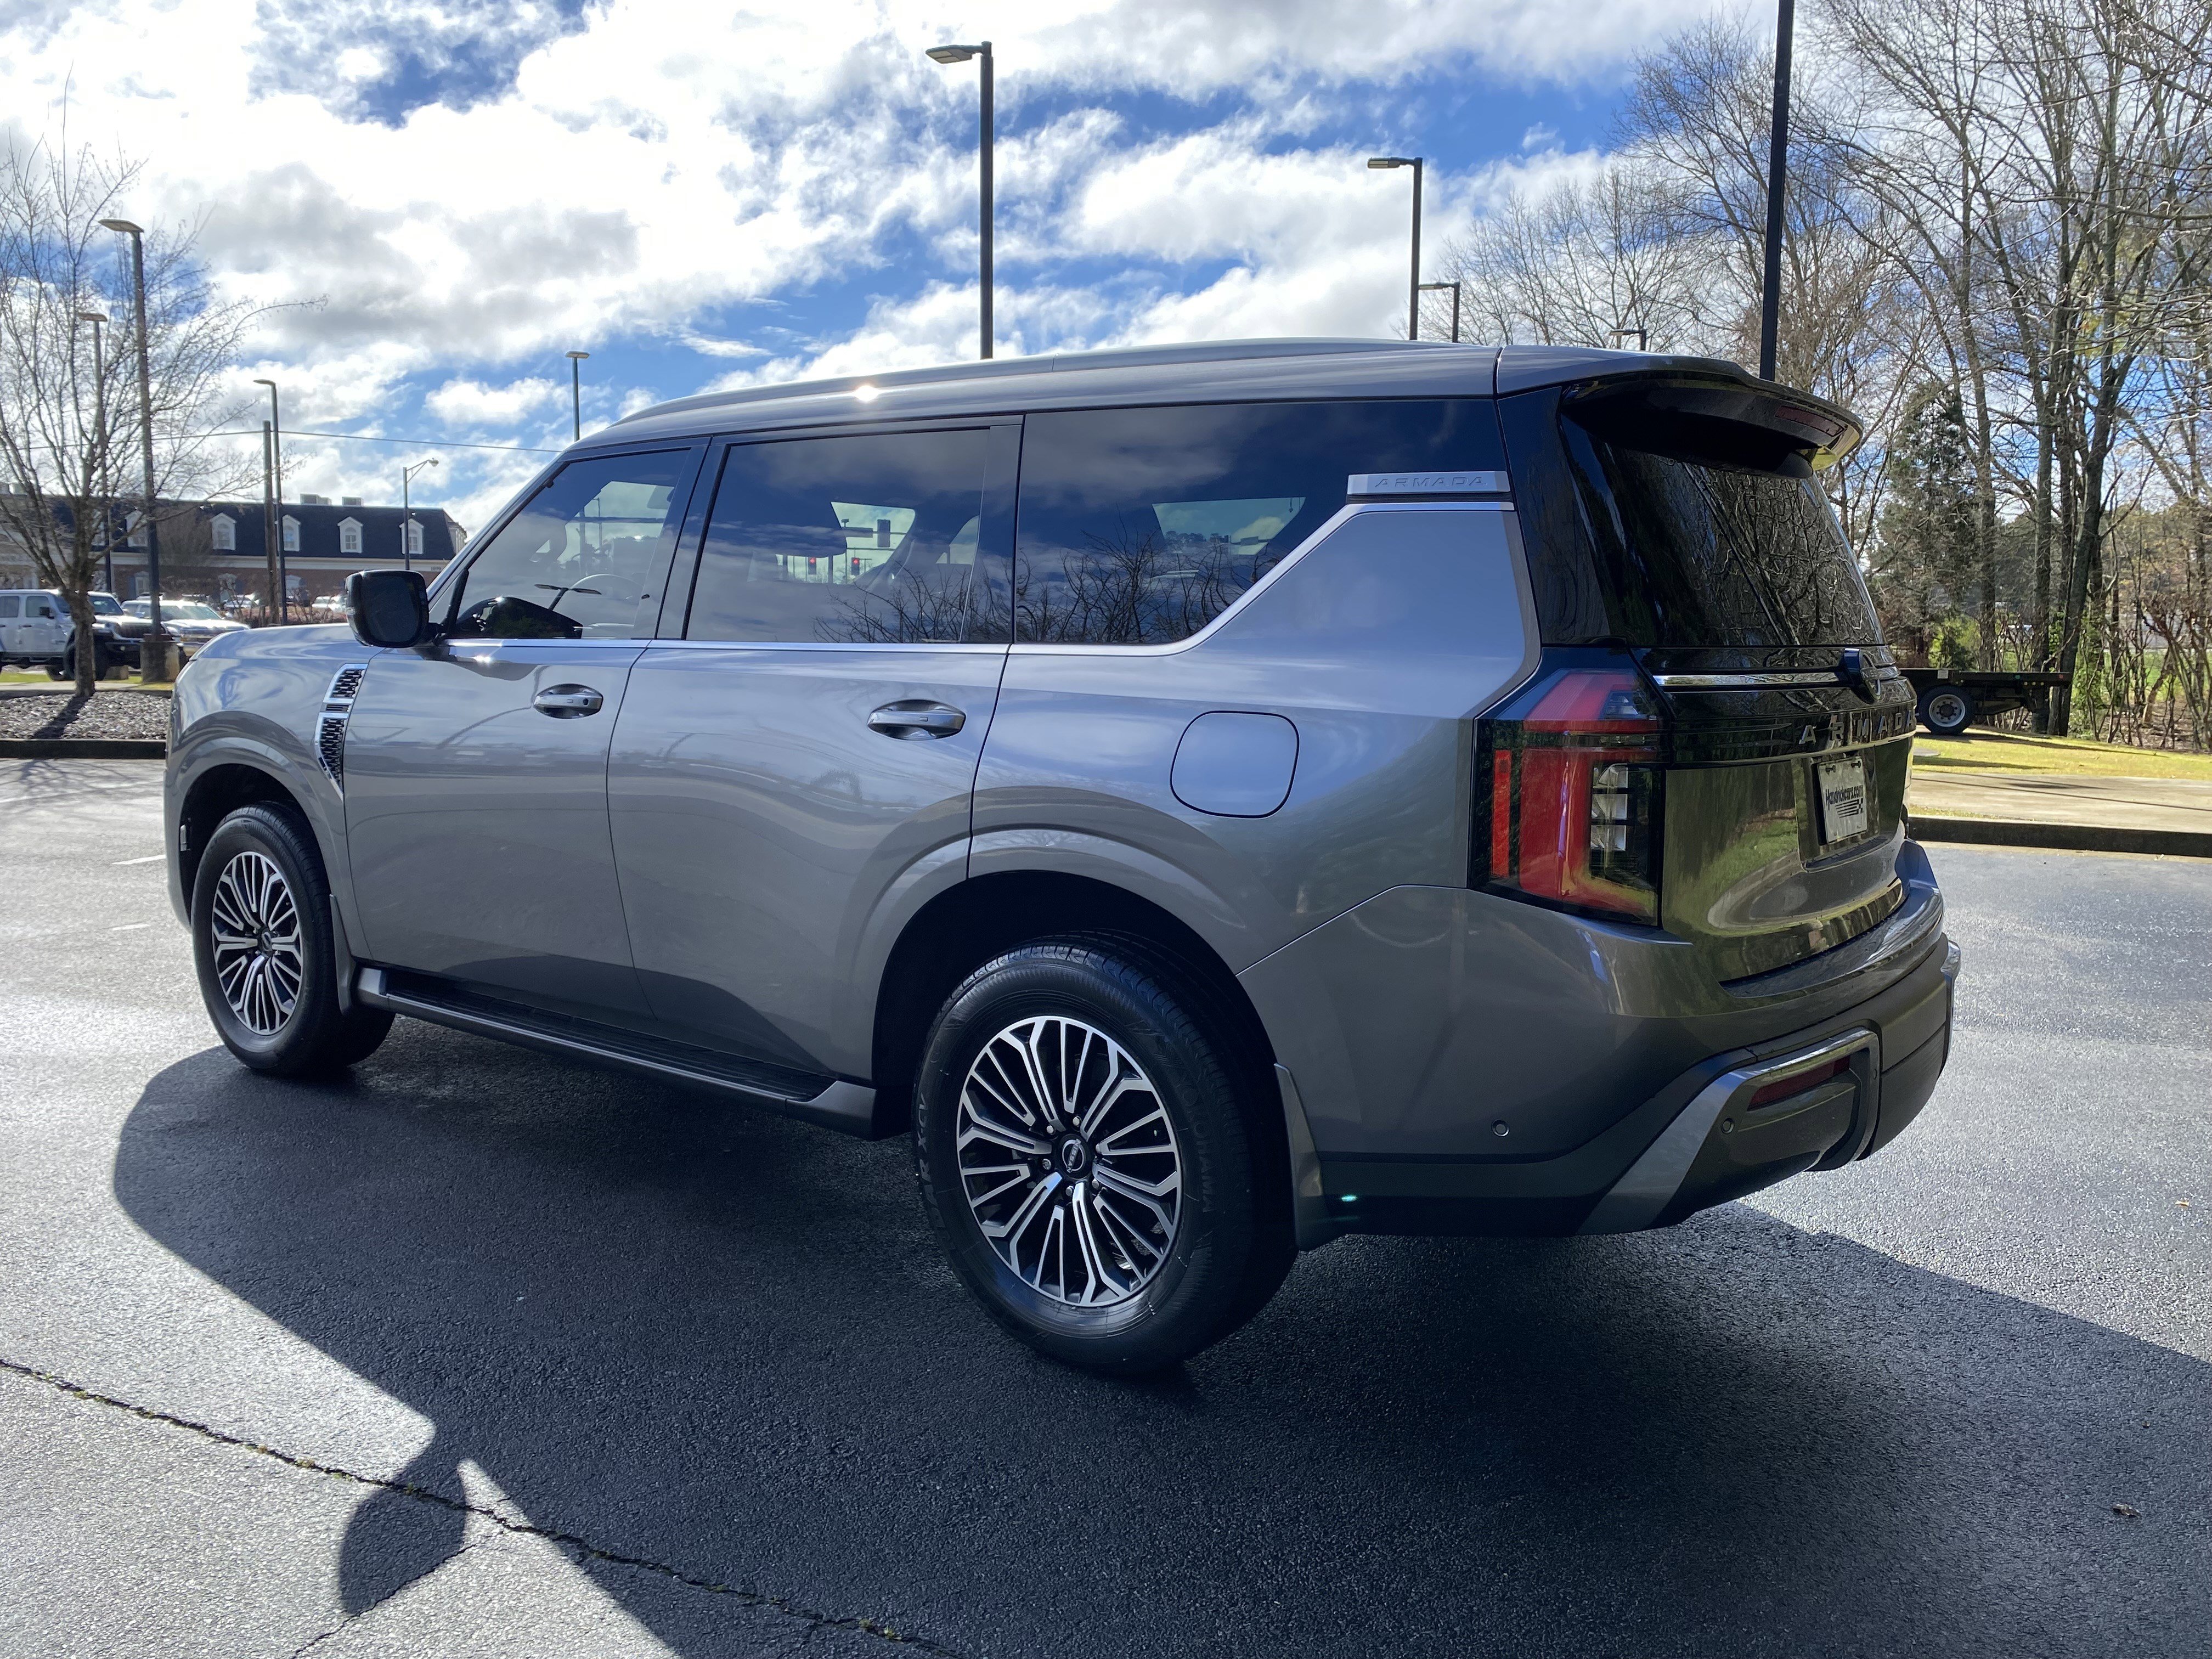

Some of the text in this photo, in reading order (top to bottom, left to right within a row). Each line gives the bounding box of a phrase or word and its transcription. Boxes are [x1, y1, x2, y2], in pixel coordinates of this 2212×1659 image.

[1375, 476, 1485, 487] ARMADA
[1798, 710, 1913, 745] ARMADA
[1066, 1138, 1081, 1173] NISSAN
